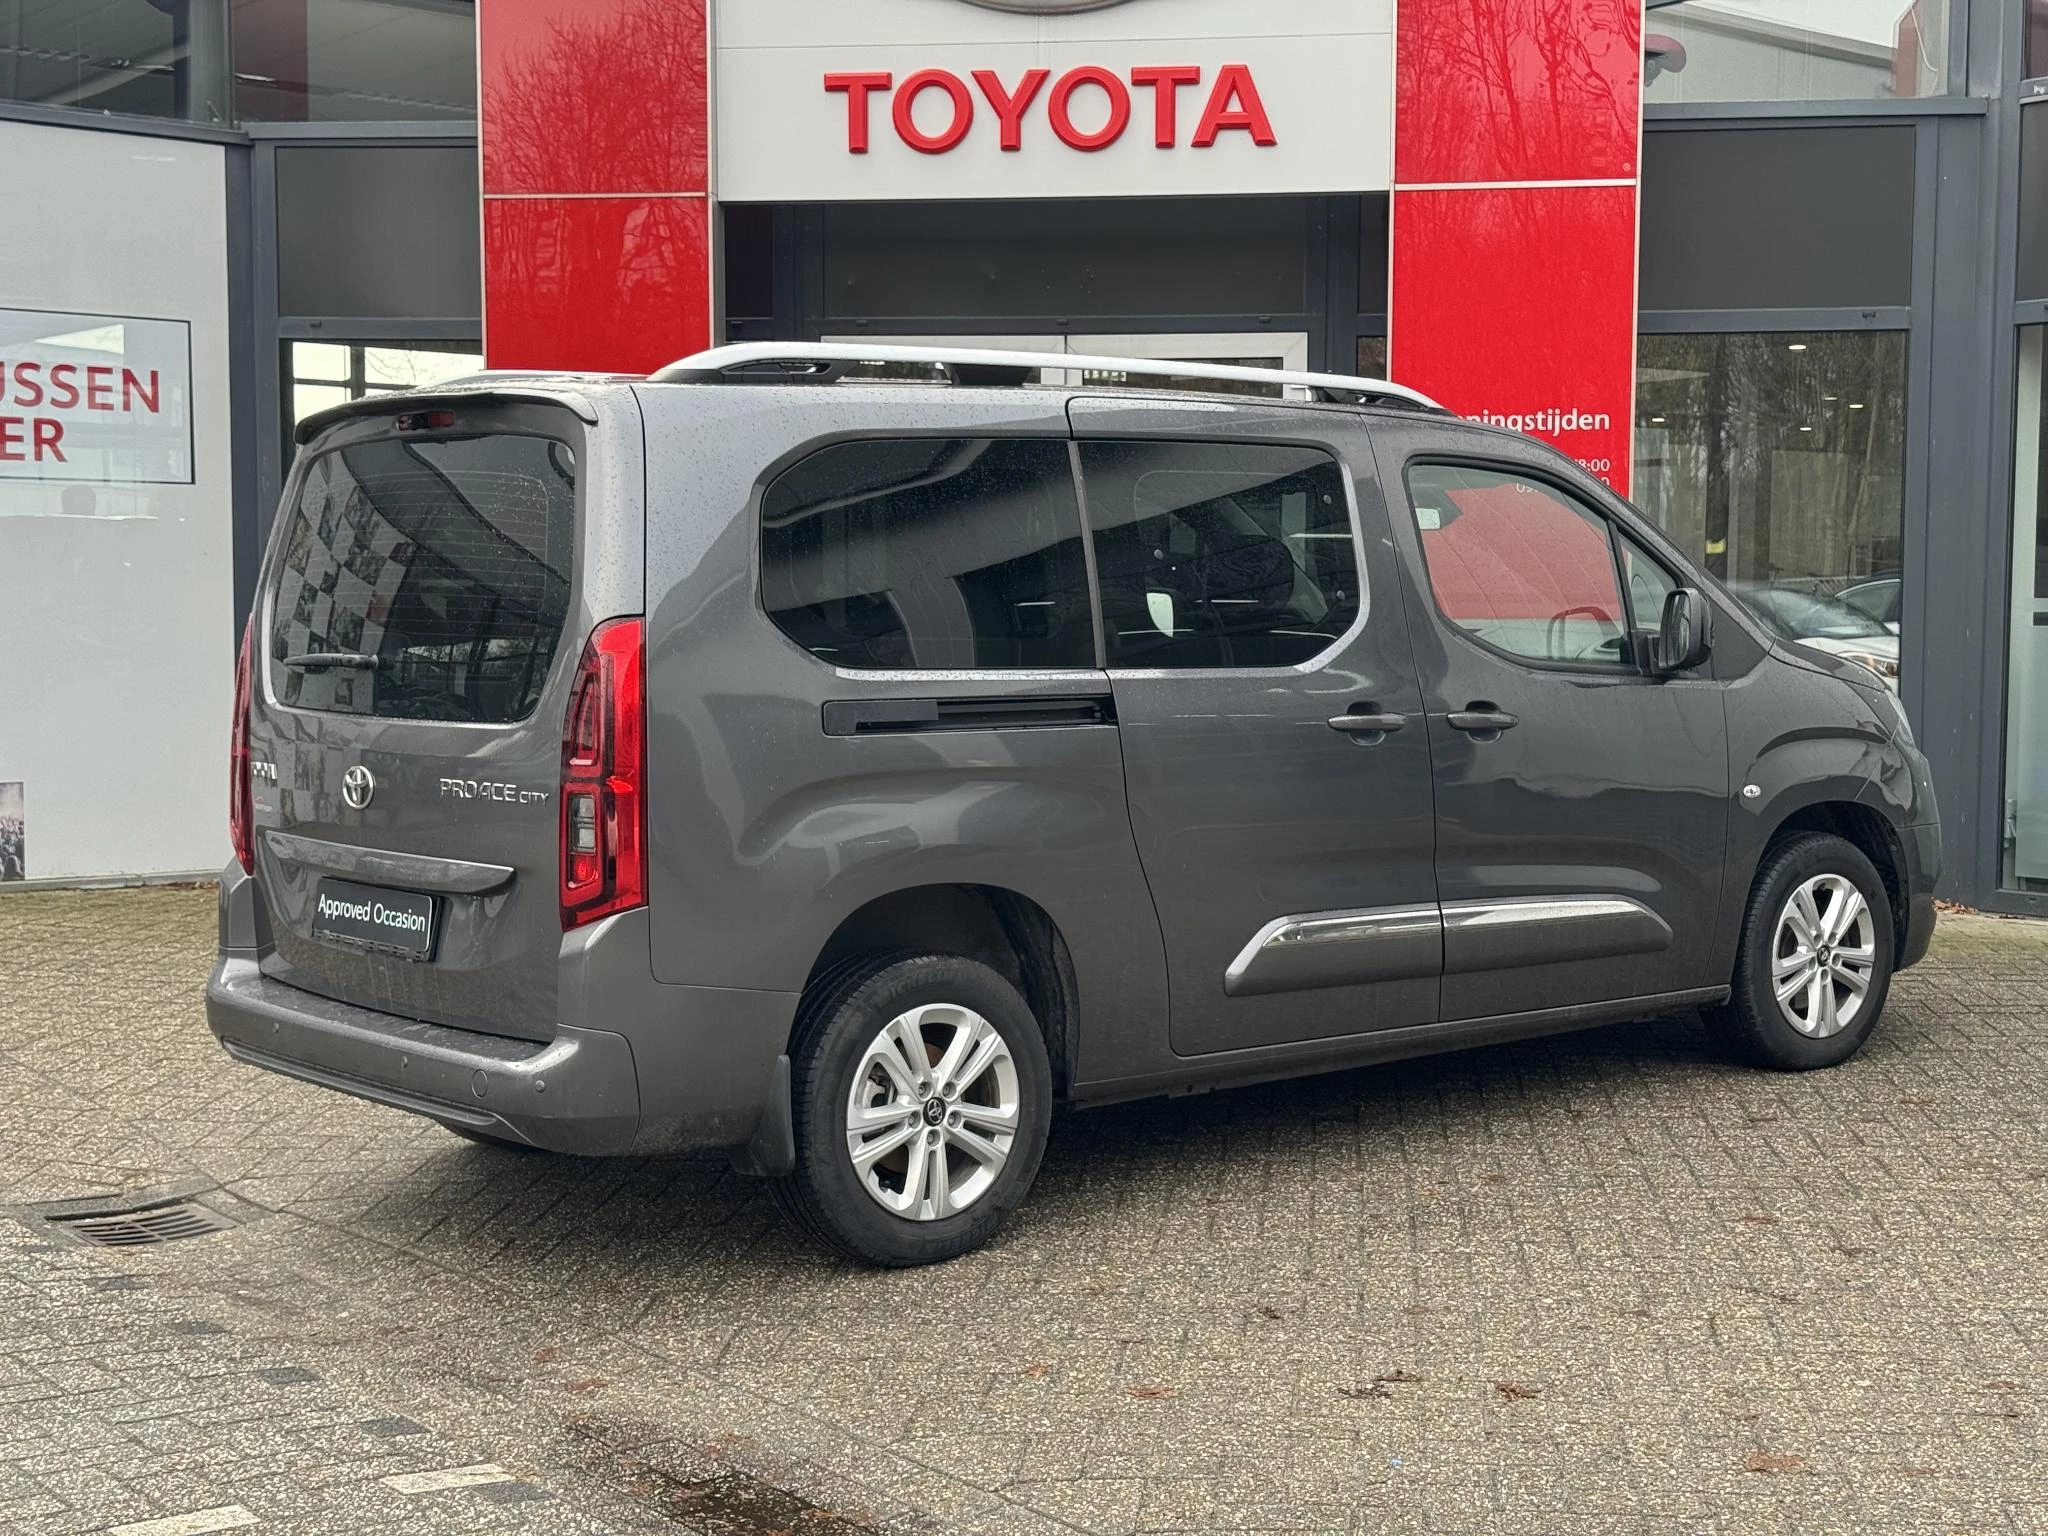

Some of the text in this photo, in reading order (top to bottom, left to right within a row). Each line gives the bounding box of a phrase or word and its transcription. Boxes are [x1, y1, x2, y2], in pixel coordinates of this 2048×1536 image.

[823, 64, 1278, 155] TOYOTA
[0, 361, 160, 414] SSEN
[1457, 408, 1610, 437] ingstijden
[1574, 458, 1611, 472] 8:00
[440, 778, 549, 805] PROACE CITY
[318, 893, 426, 932] Approved Occasion
